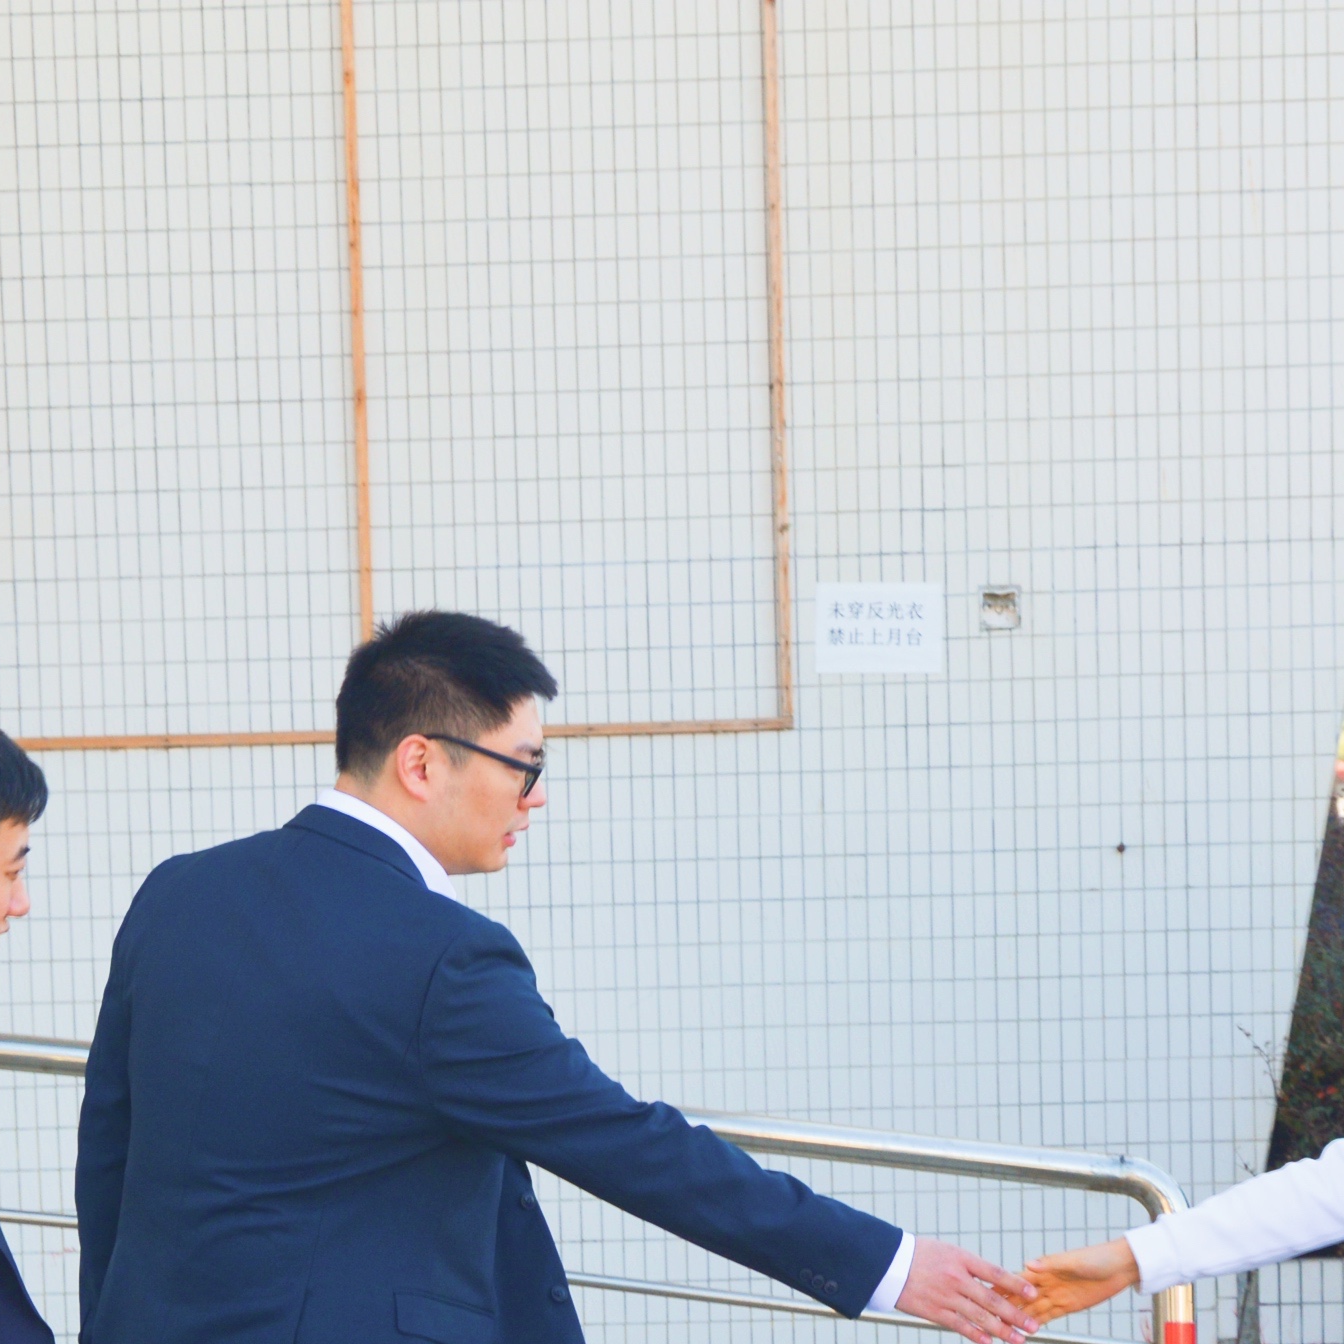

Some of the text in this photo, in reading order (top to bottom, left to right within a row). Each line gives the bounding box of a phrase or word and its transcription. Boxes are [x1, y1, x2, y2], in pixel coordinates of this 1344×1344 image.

[828, 602, 923, 619] 未穿反光衣
[828, 628, 922, 646] 禁止上月台
